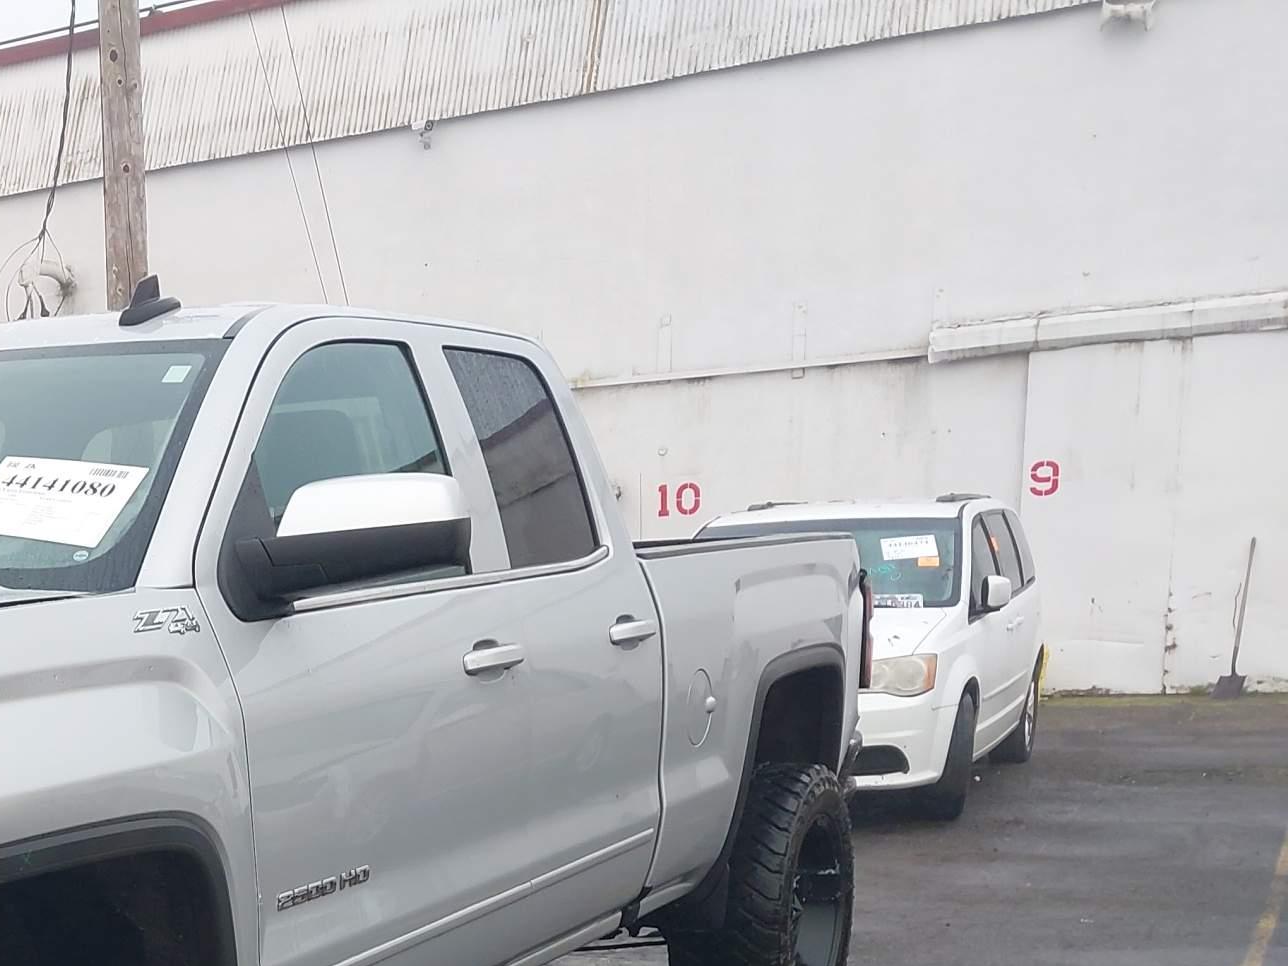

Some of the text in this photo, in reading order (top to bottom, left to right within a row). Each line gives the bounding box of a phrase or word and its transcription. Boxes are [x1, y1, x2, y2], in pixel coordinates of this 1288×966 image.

[2, 473, 117, 498] 44141080
[1029, 460, 1059, 497] 9
[658, 482, 701, 517] 10
[276, 864, 370, 912] 2500 HD
